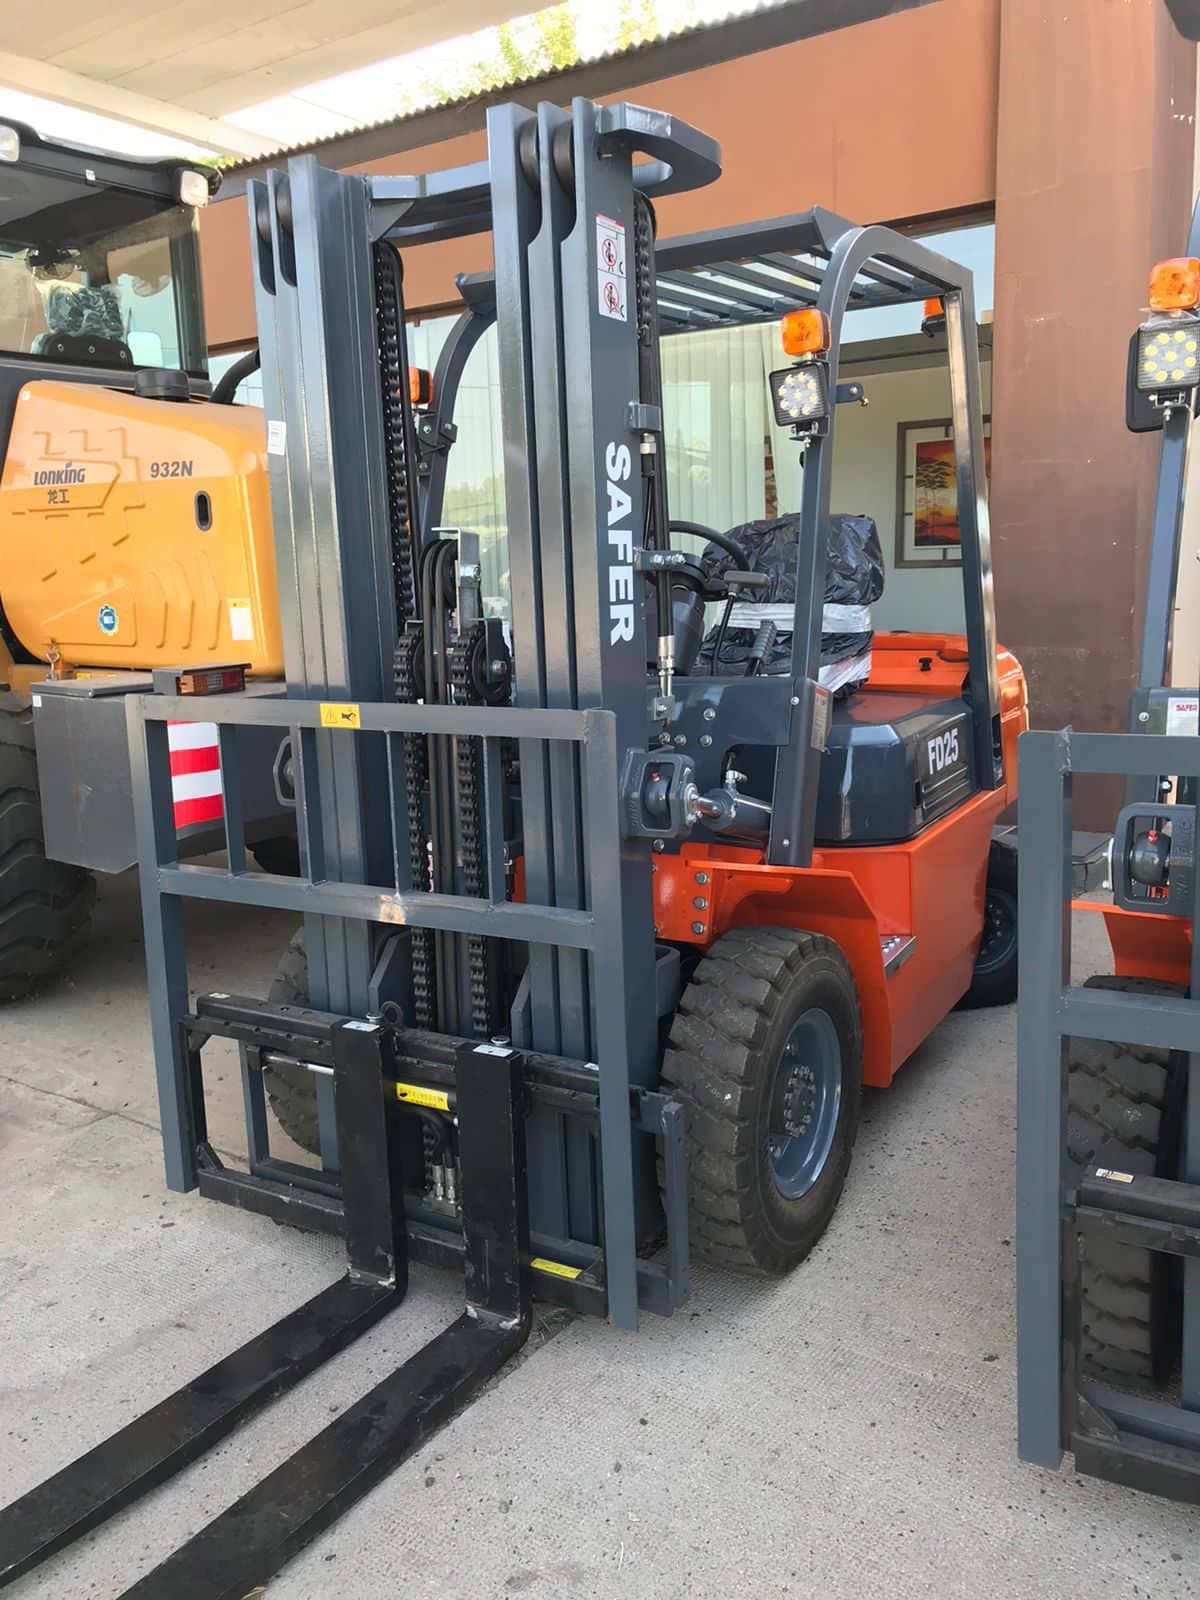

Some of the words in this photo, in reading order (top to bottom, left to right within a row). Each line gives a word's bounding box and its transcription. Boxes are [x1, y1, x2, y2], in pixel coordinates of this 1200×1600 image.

[151, 460, 193, 478] 932N
[605, 441, 635, 646] SAFER
[928, 728, 959, 775] FD25
